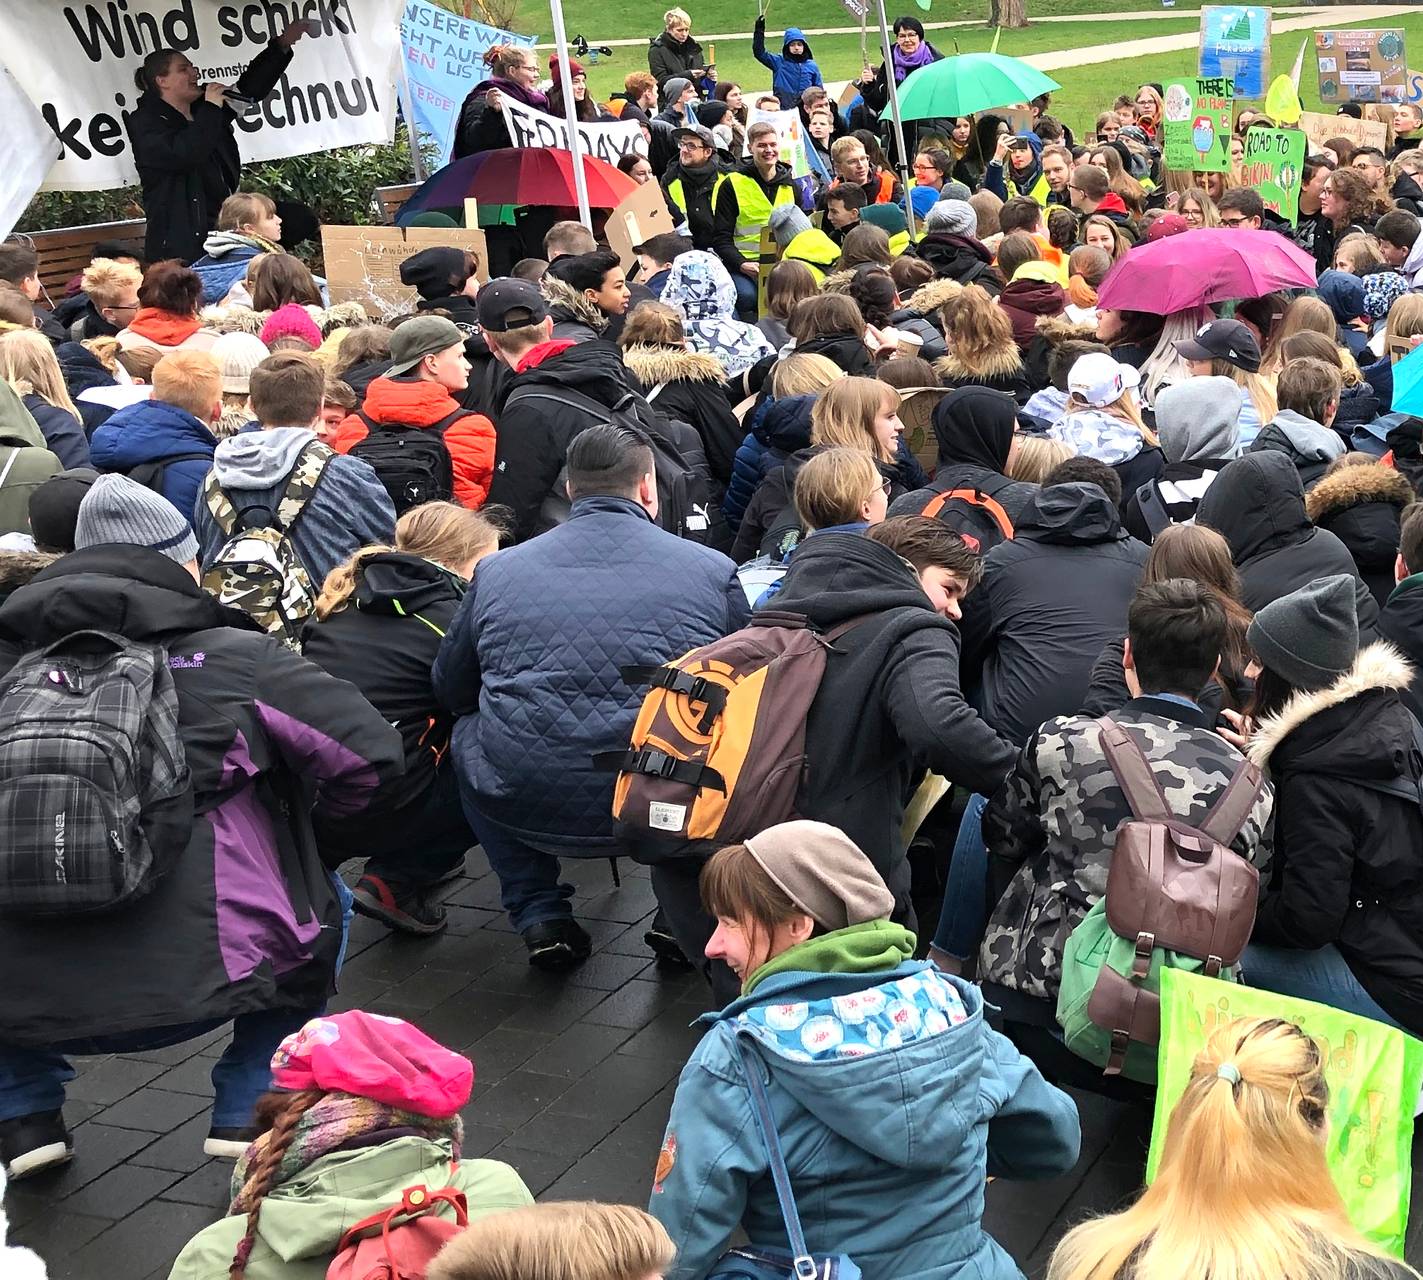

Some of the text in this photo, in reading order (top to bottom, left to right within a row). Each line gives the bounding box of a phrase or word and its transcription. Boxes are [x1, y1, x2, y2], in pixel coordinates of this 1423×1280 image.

[64, 0, 200, 62] Wind
[402, 4, 470, 41] NSERE
[193, 62, 250, 79] Brennsto
[446, 61, 490, 80] LIST
[1196, 78, 1224, 97] THERE
[1248, 131, 1289, 158] ROAD TO
